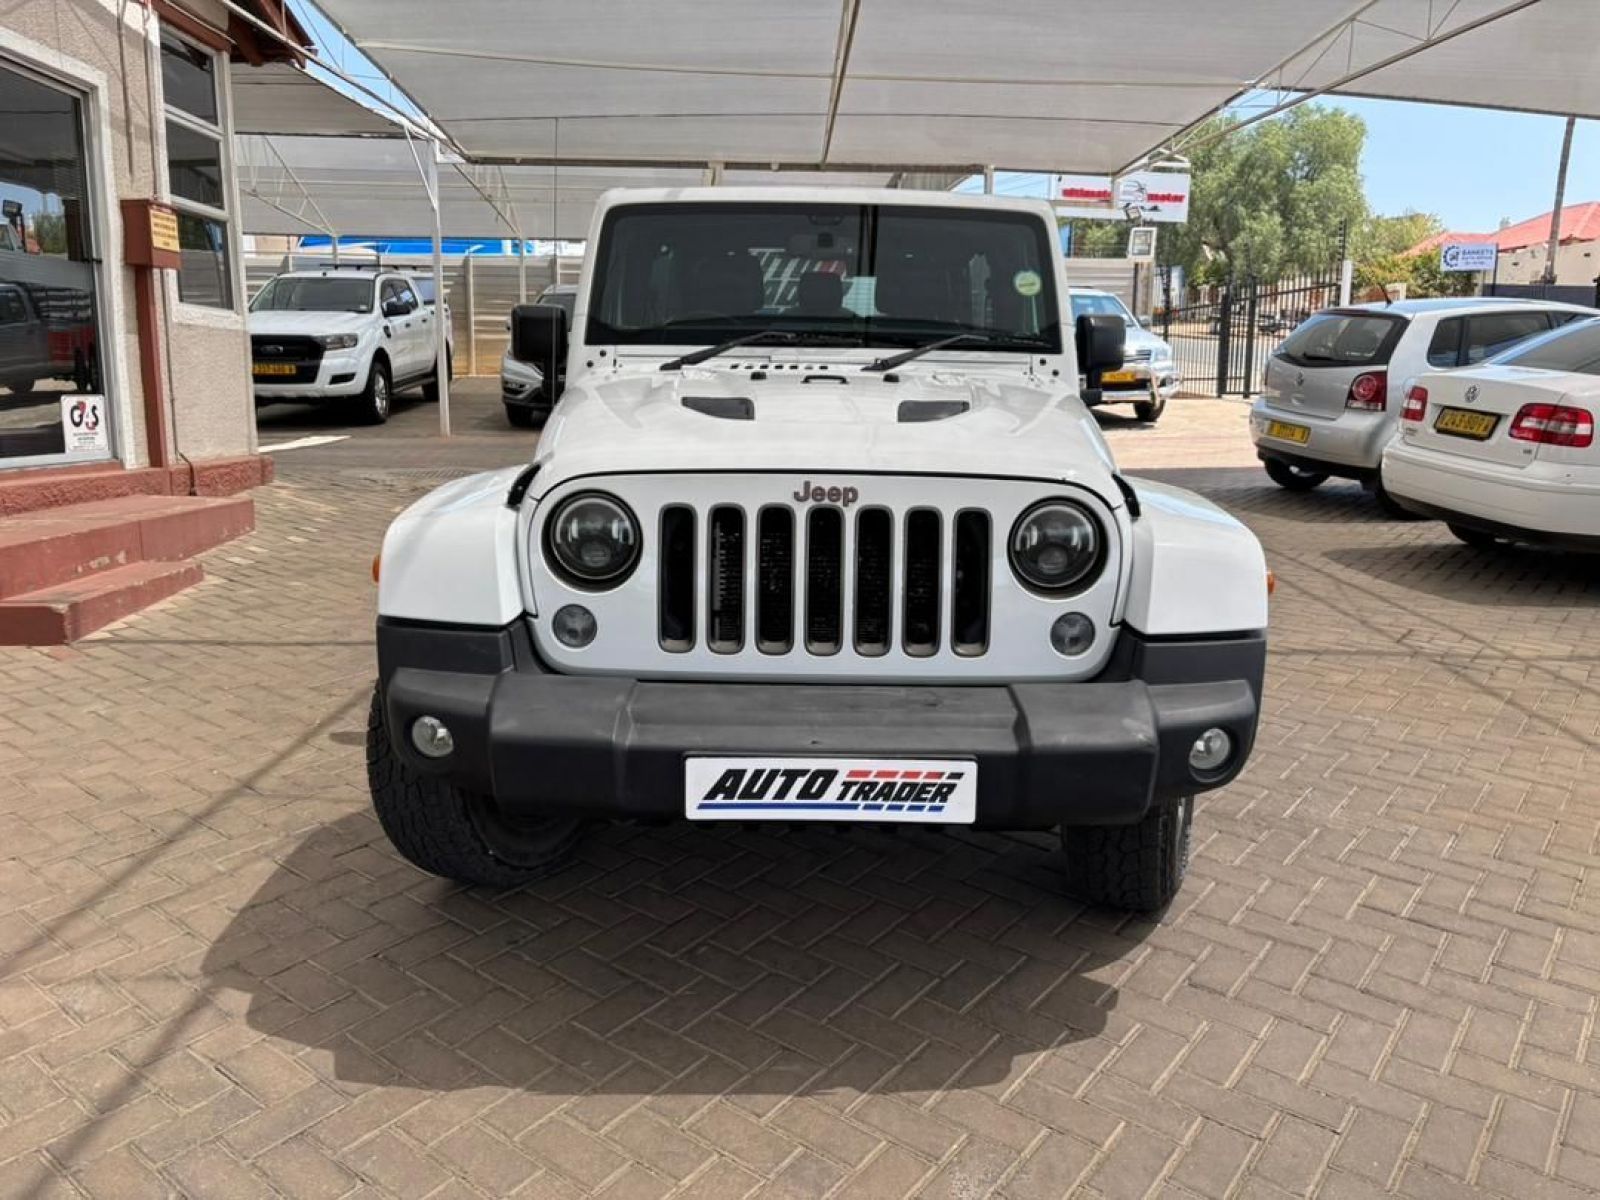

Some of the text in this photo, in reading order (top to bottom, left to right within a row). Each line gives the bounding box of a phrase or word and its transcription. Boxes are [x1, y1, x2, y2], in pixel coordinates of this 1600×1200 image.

[794, 480, 858, 507] Jeep
[703, 768, 957, 804] AUTO TRADER
